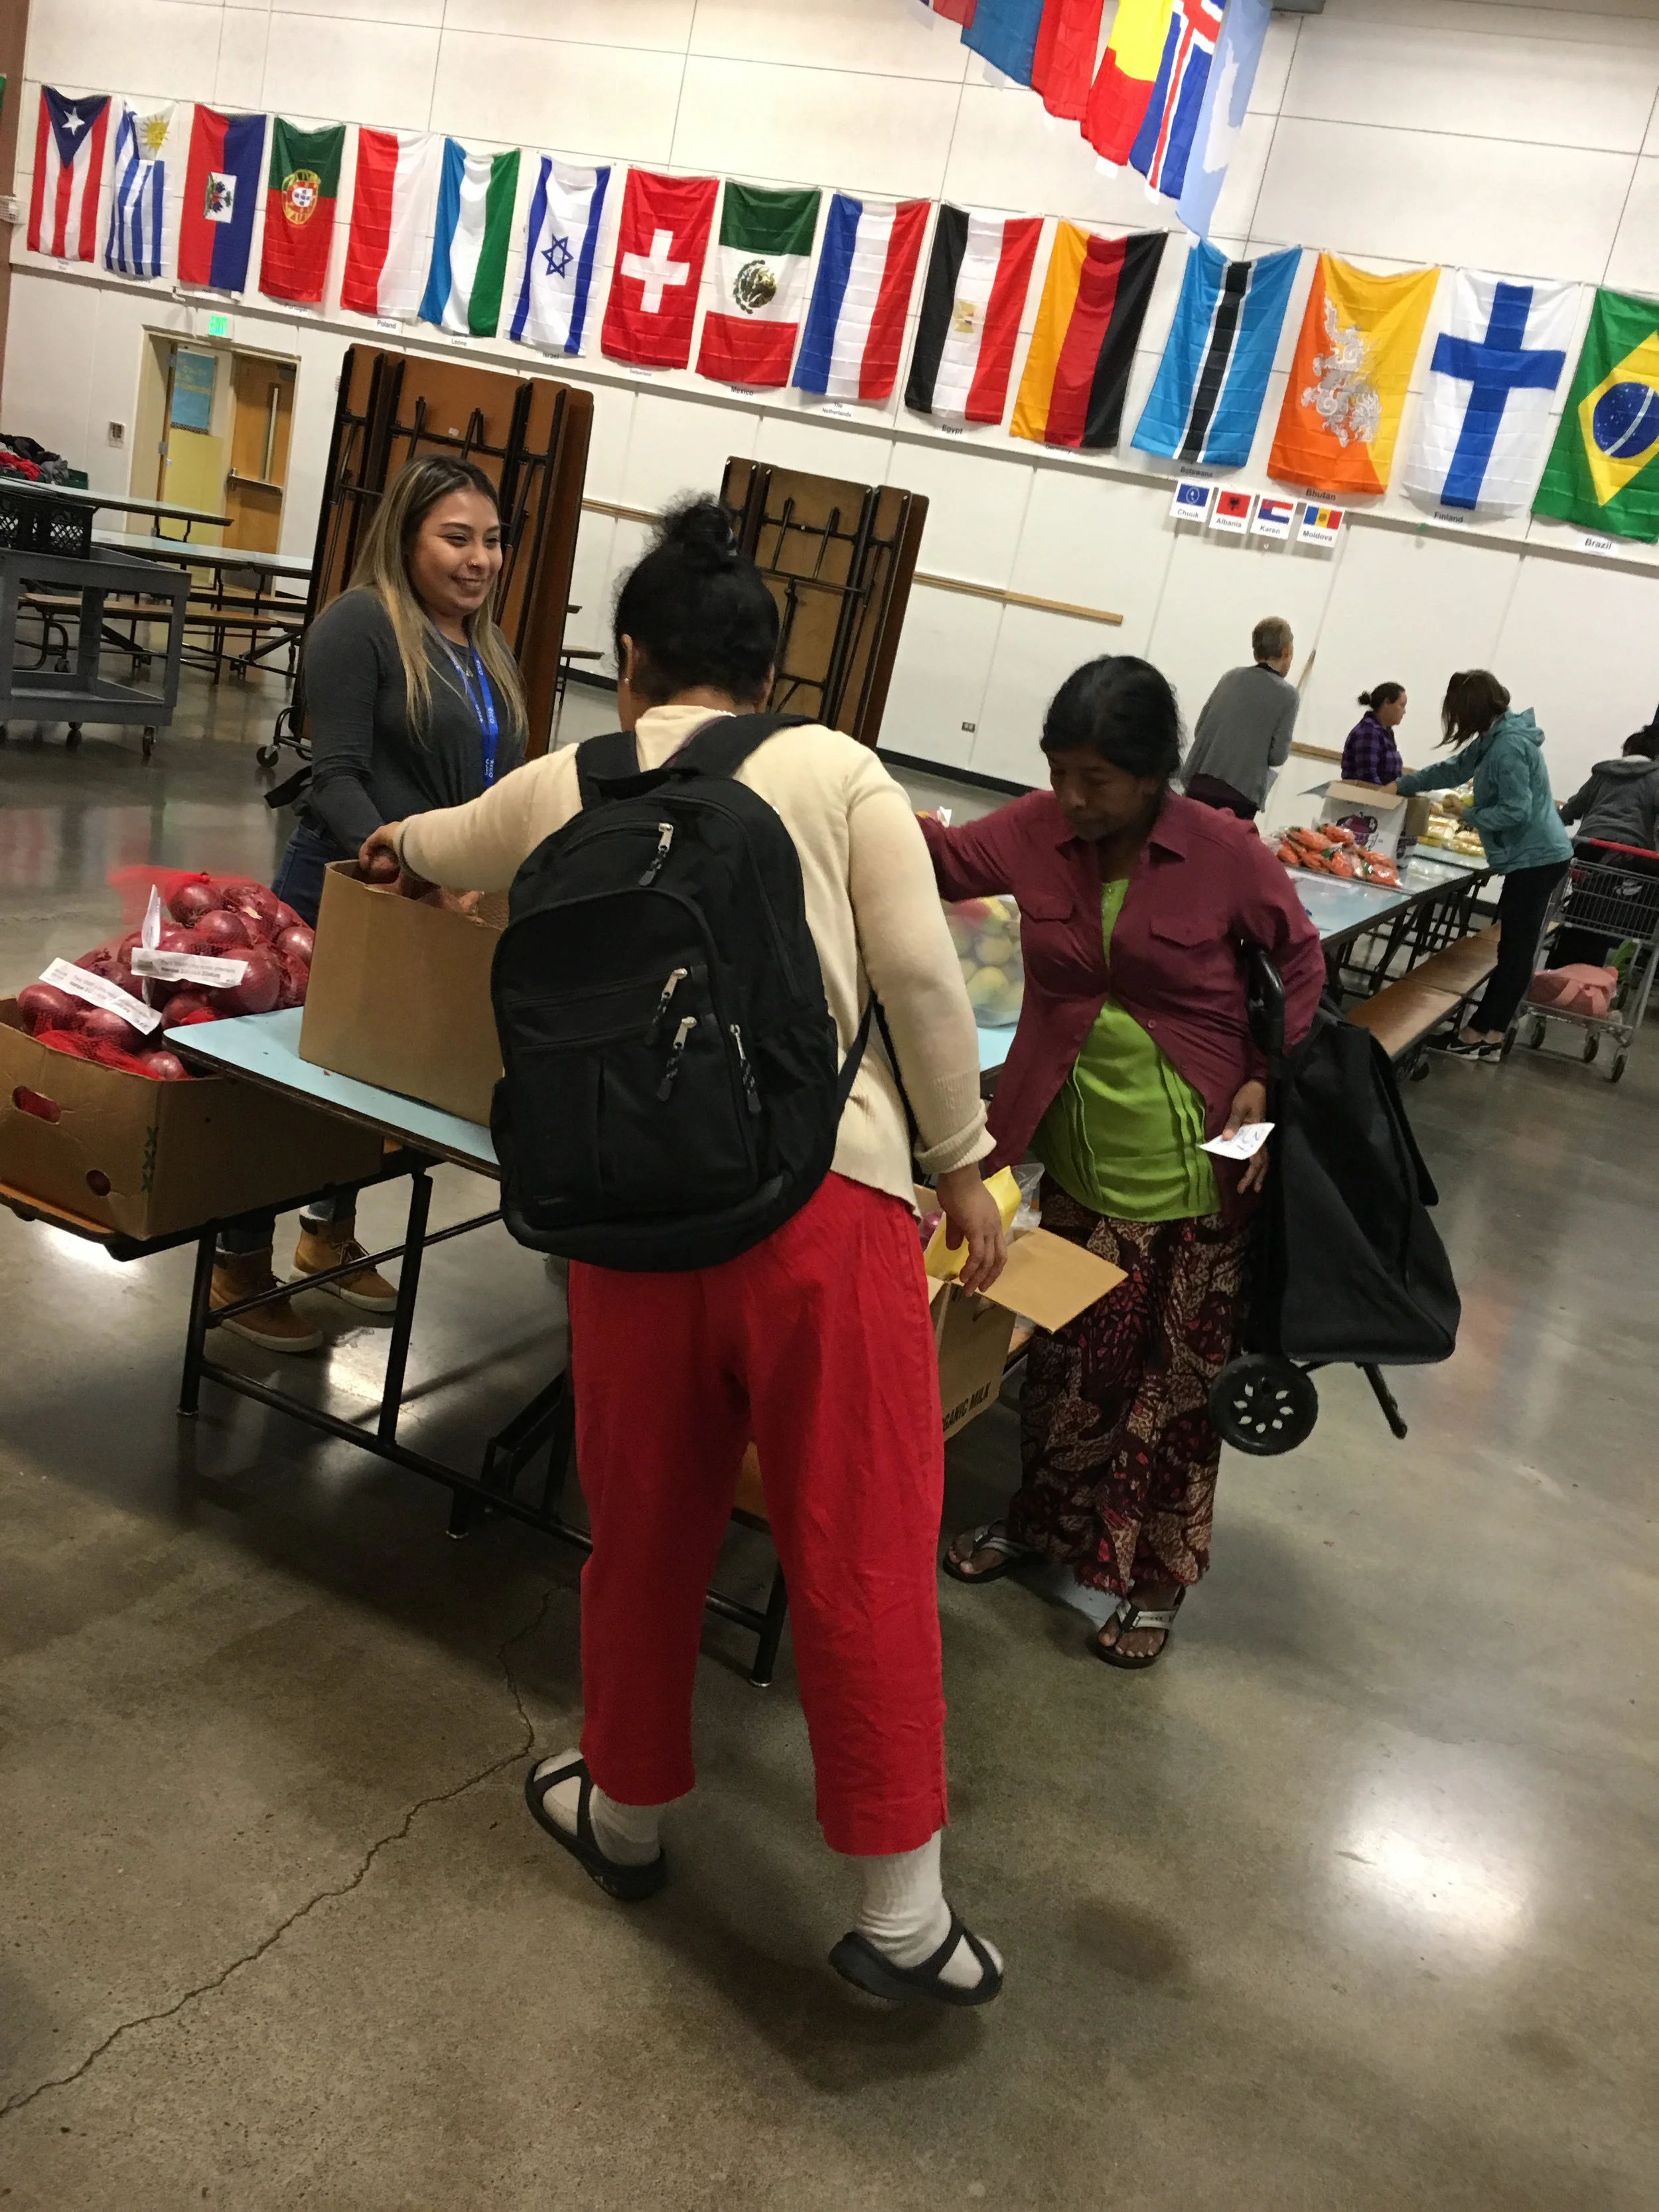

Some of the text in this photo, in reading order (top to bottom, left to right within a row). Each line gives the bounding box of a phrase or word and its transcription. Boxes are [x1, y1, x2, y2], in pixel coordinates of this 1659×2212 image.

[210, 315, 227, 336] EXIT
[377, 320, 396, 329] Poland
[730, 386, 754, 396] Mexico
[822, 407, 851, 417] Netherlands
[942, 424, 963, 435] Egypt
[1180, 466, 1213, 477] Botswana
[1305, 488, 1336, 501] Bhutan
[1177, 508, 1198, 518] Chuuk
[1434, 510, 1464, 523] Finland
[1216, 518, 1242, 528] Albania
[1260, 525, 1280, 534] Karen
[1303, 530, 1333, 542] Moldova
[1585, 538, 1613, 550] Brazil
[969, 1381, 991, 1412] MILK
